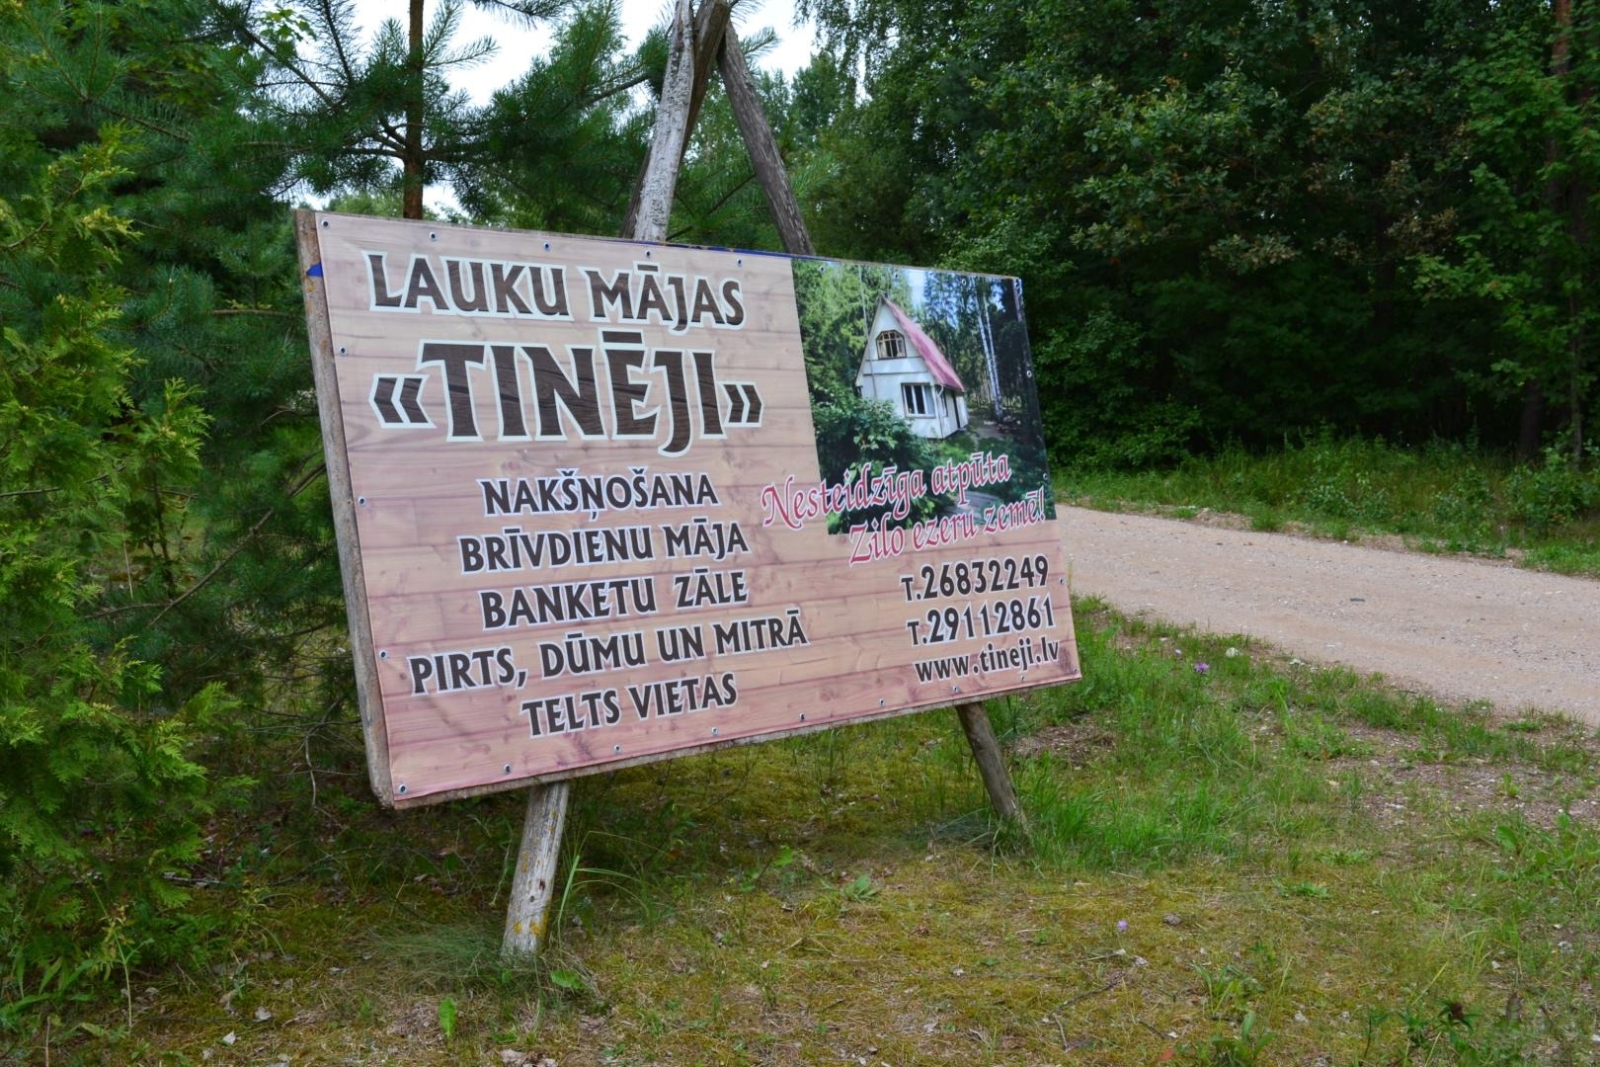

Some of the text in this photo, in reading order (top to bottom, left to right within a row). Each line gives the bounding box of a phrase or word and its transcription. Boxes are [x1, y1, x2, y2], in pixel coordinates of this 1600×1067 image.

[366, 253, 744, 333] LAUKU MĀJAS
[480, 468, 720, 520] NAKŠŅOŠANA
[761, 451, 1011, 529] Nesteidzīga atpūta
[460, 518, 750, 572] BRĪVDIENU MĀJA
[850, 488, 1046, 565] Zilo ezeru zemē!
[481, 568, 748, 629] BANKETU ZĀLE
[409, 610, 808, 694] PIRTS, DŪMU UN MITRĀ
[915, 637, 1060, 683] www.tineji.lv
[522, 673, 737, 736] TELTS VIETAS
